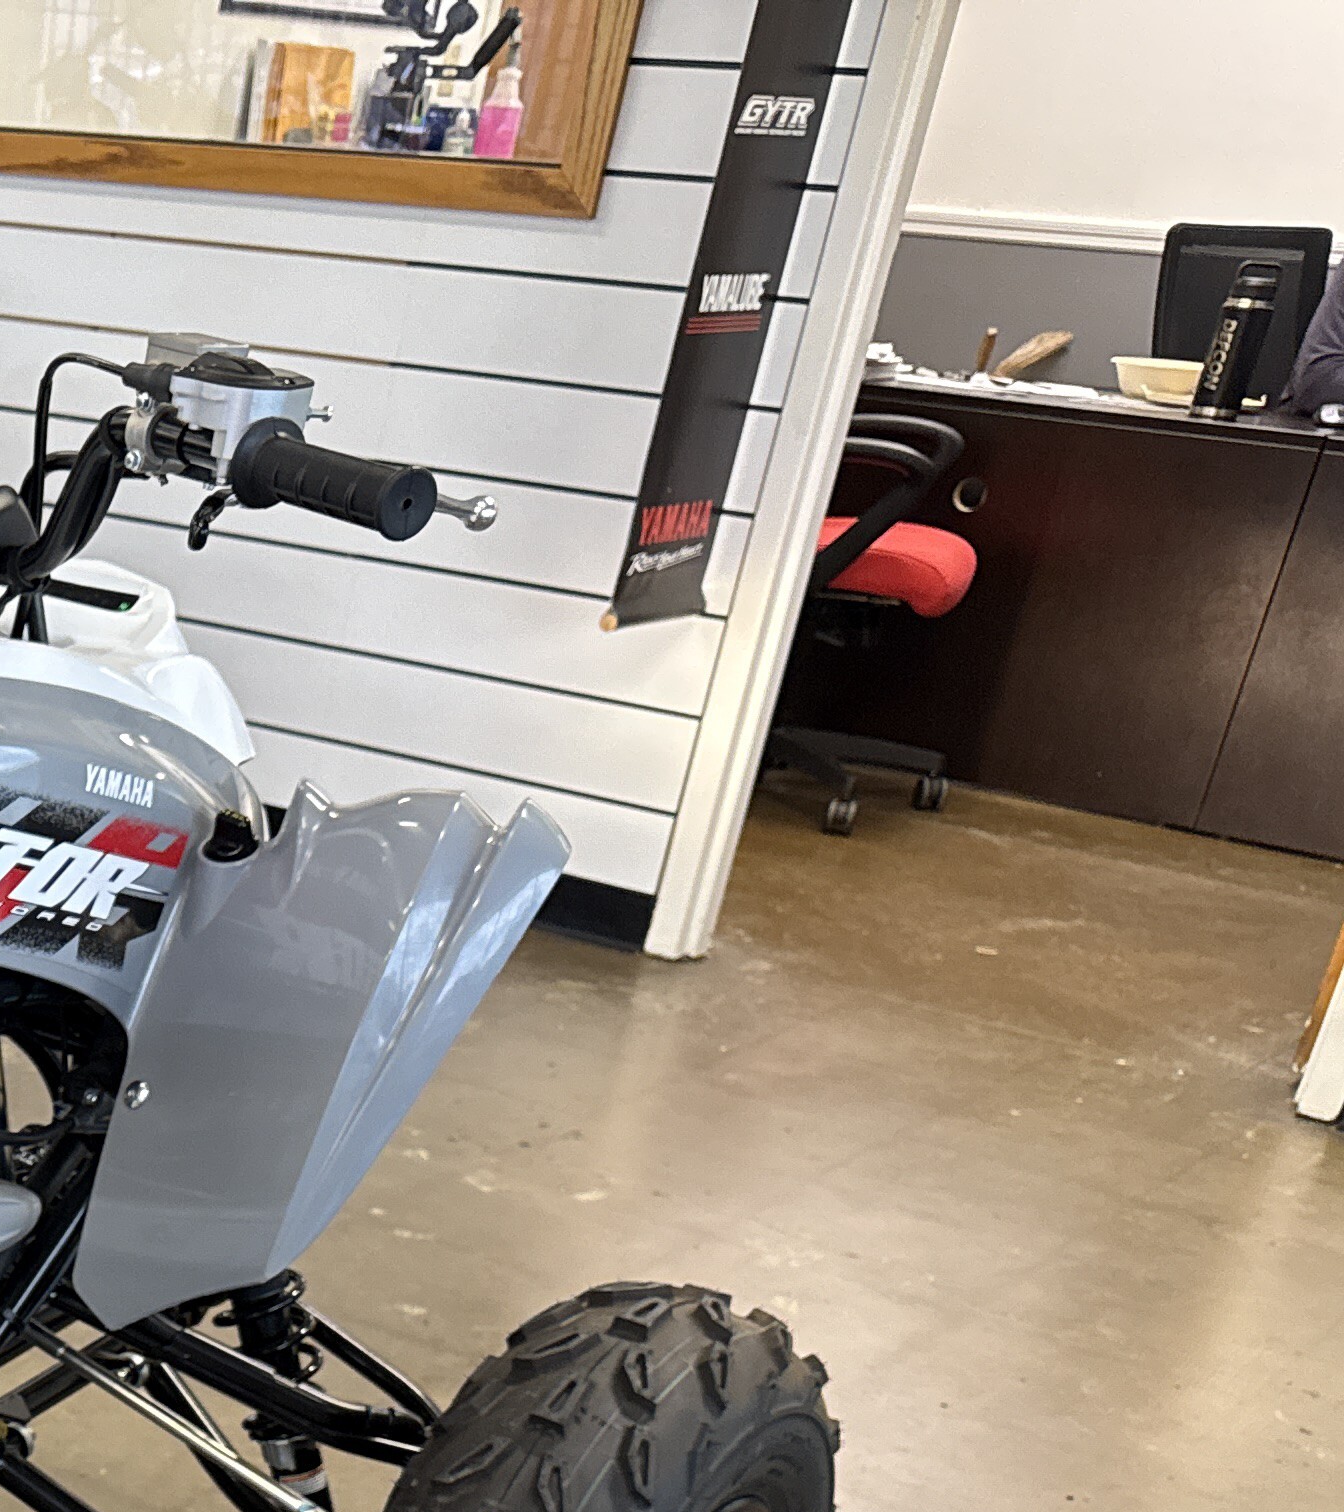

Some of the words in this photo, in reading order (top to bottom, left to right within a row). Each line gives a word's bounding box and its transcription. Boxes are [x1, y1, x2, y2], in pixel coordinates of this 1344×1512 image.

[738, 95, 815, 128] GYTR
[698, 273, 768, 313] YAMALUBE
[1203, 318, 1238, 391] DEFCON
[638, 500, 713, 546] YAMAHA
[84, 763, 154, 809] YAMAHA
